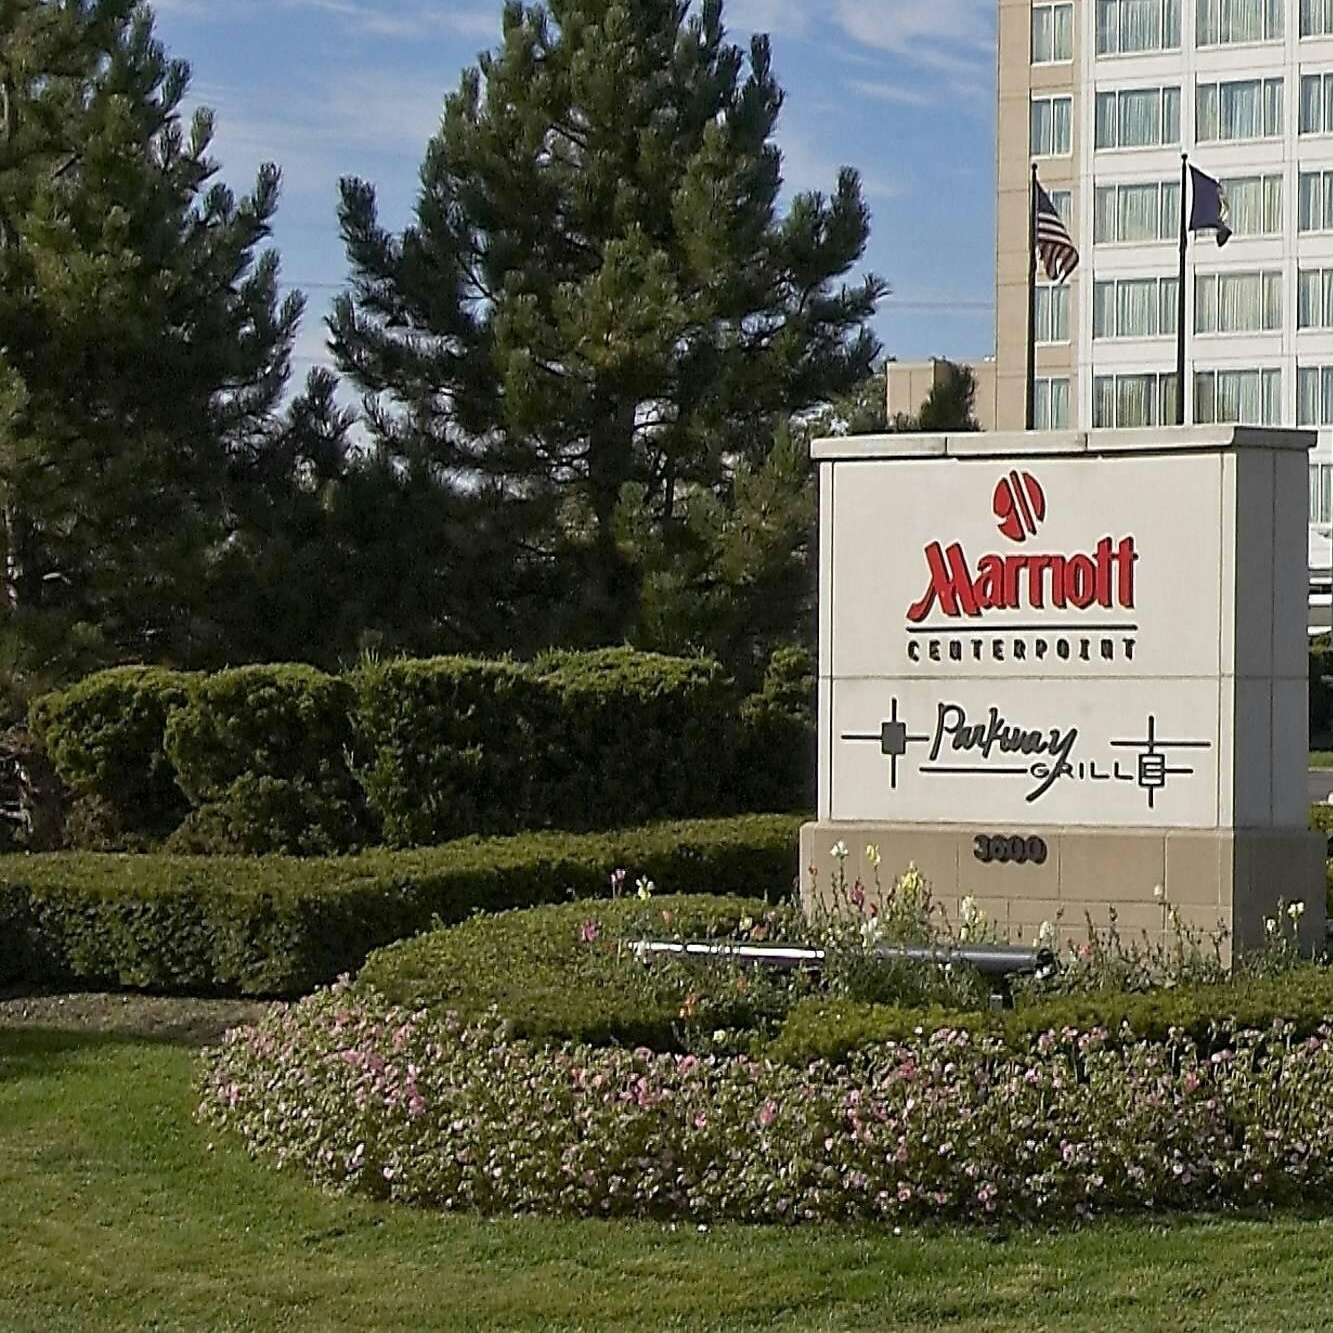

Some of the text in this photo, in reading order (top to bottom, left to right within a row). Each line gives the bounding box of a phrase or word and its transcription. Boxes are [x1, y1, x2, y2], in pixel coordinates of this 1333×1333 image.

[906, 537, 1138, 622] Marriott
[907, 639, 1136, 661] CENTERPOINT
[930, 702, 1078, 802] Parkway
